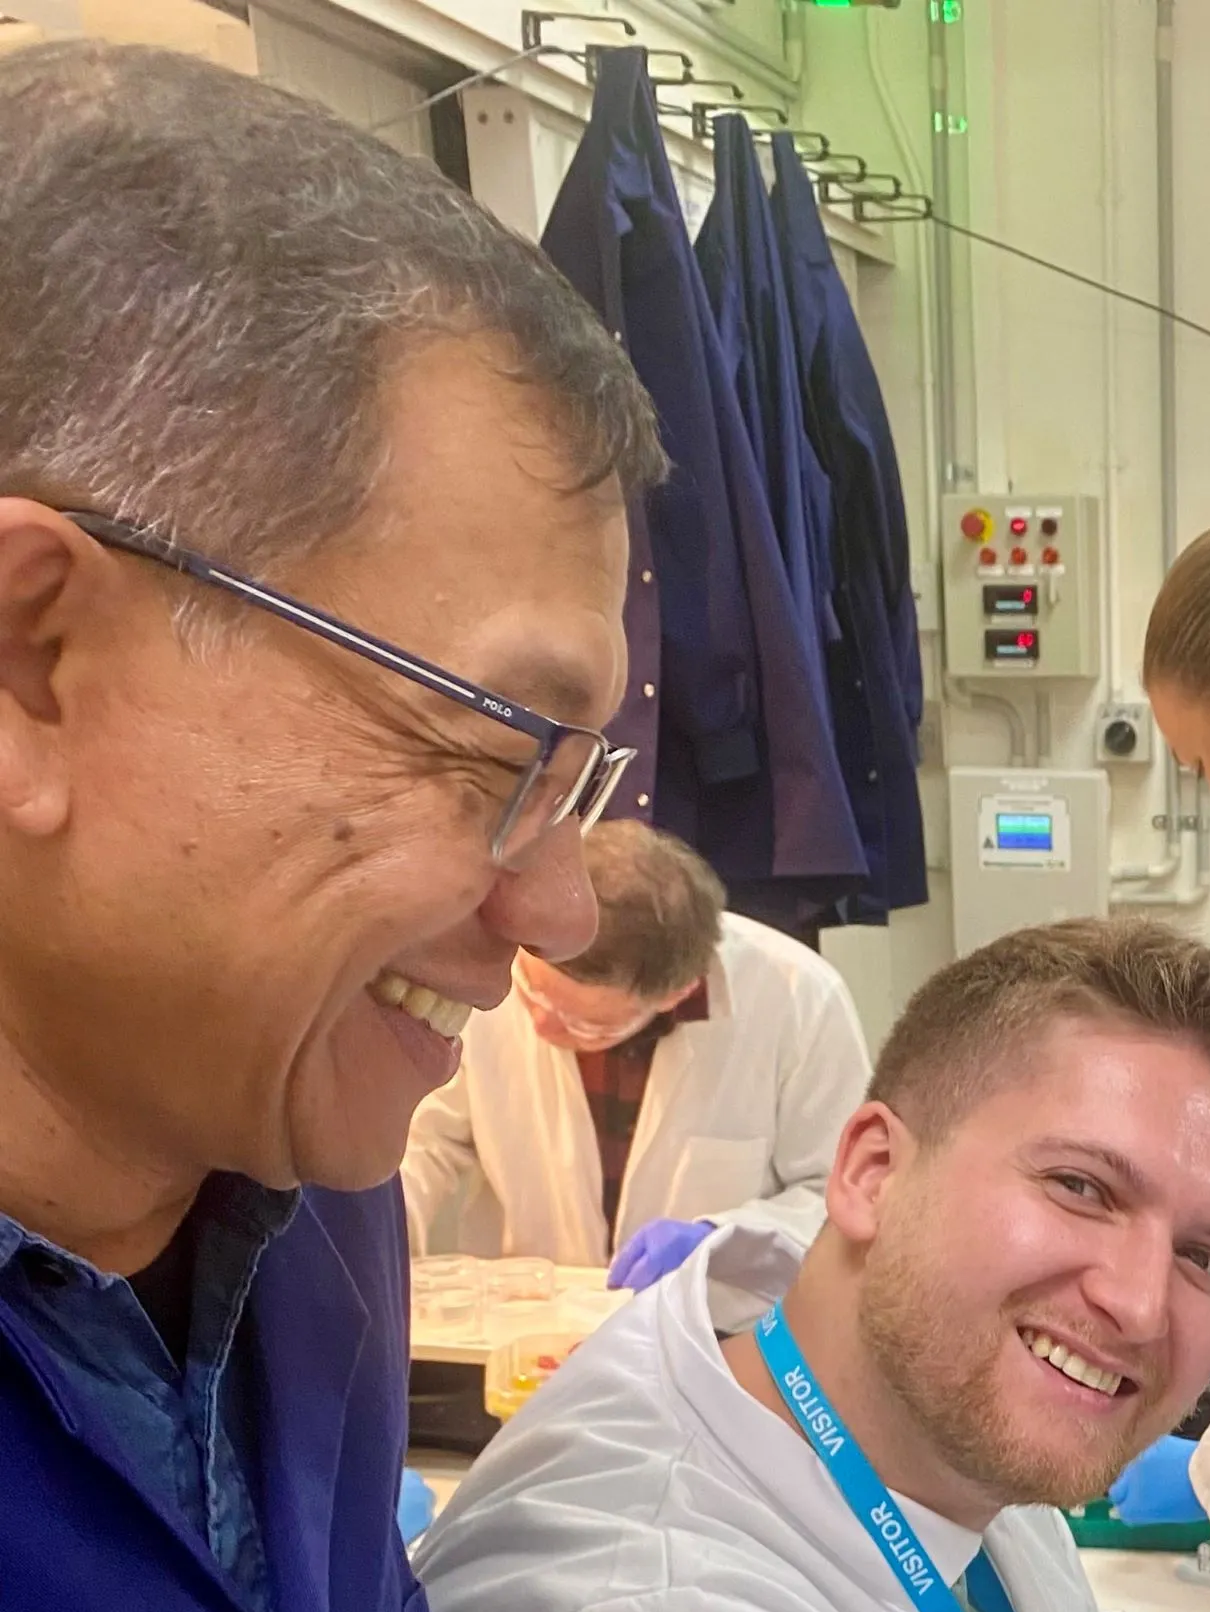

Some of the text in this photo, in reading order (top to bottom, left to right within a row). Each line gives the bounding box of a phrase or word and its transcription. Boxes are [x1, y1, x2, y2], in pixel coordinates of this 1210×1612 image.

[482, 696, 512, 718] POLO
[784, 1365, 845, 1456] VISITOR
[870, 1500, 934, 1596] VISITOR
